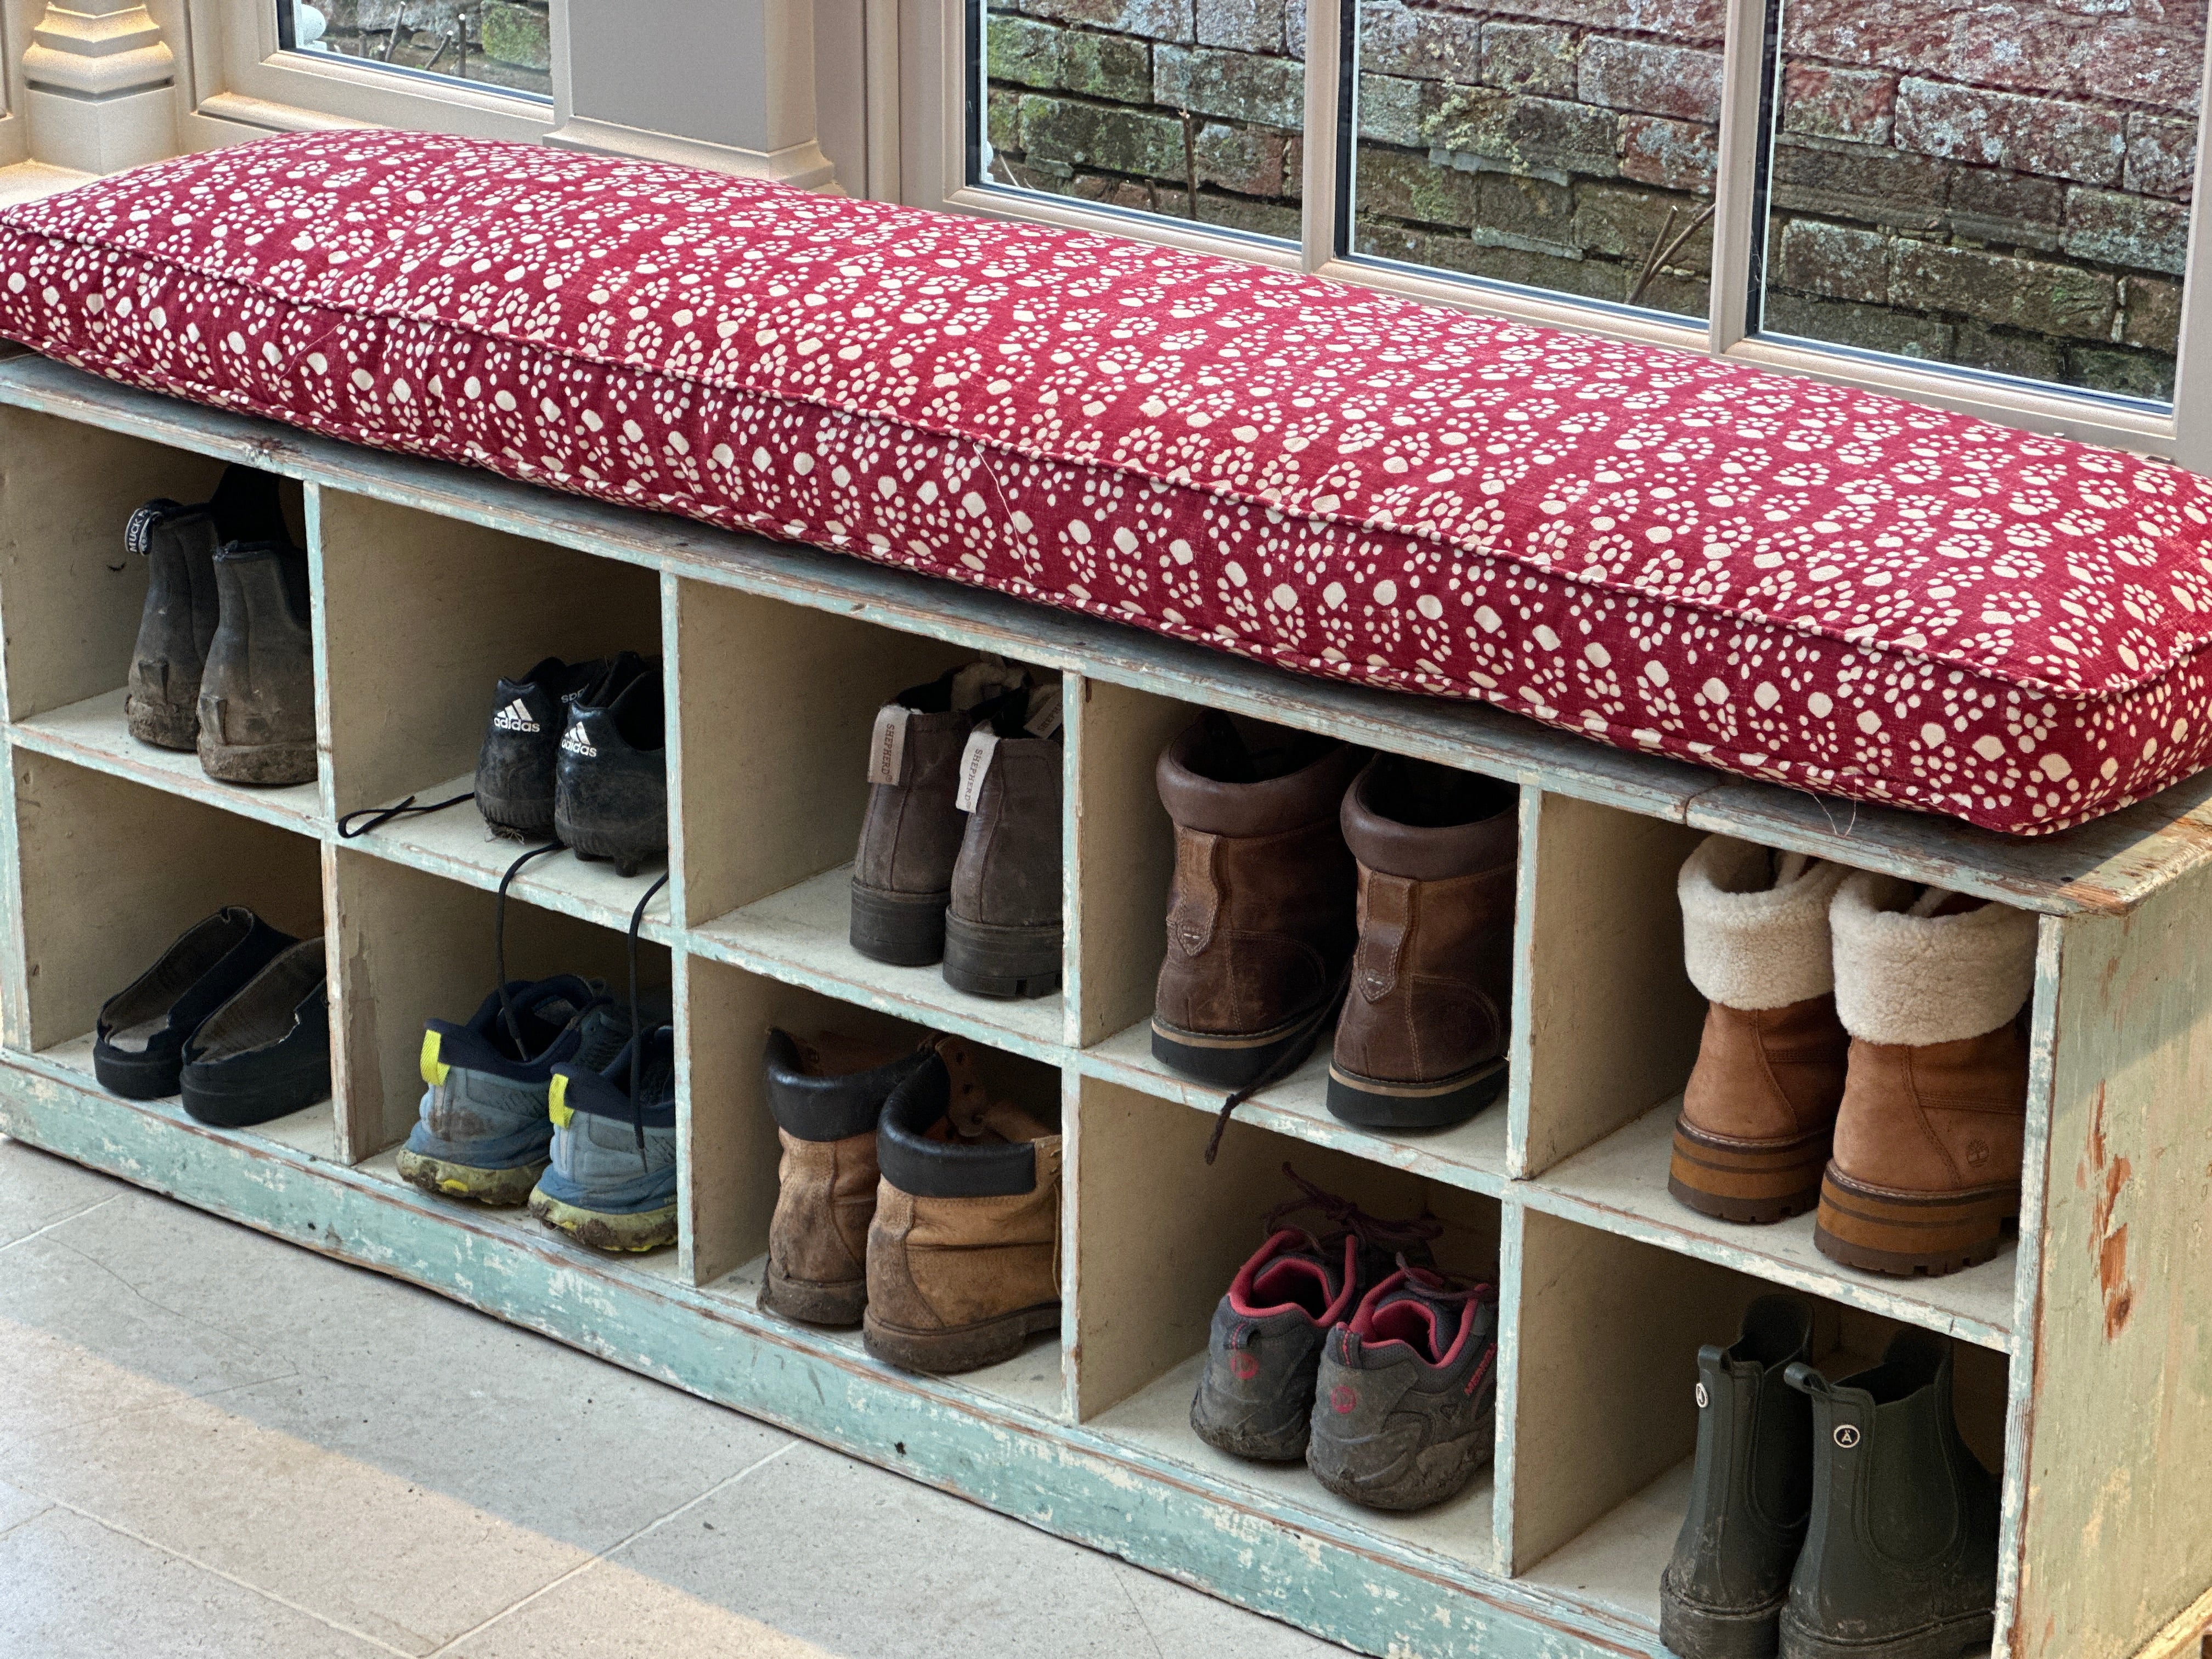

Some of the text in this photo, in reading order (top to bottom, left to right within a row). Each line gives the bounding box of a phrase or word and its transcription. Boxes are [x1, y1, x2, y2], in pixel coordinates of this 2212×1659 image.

[129, 517, 143, 552] MUCK
[494, 716, 540, 732] adidas
[561, 739, 597, 758] adidas
[882, 723, 895, 776] SHEPHERD
[964, 748, 983, 805] SHEPHERD
